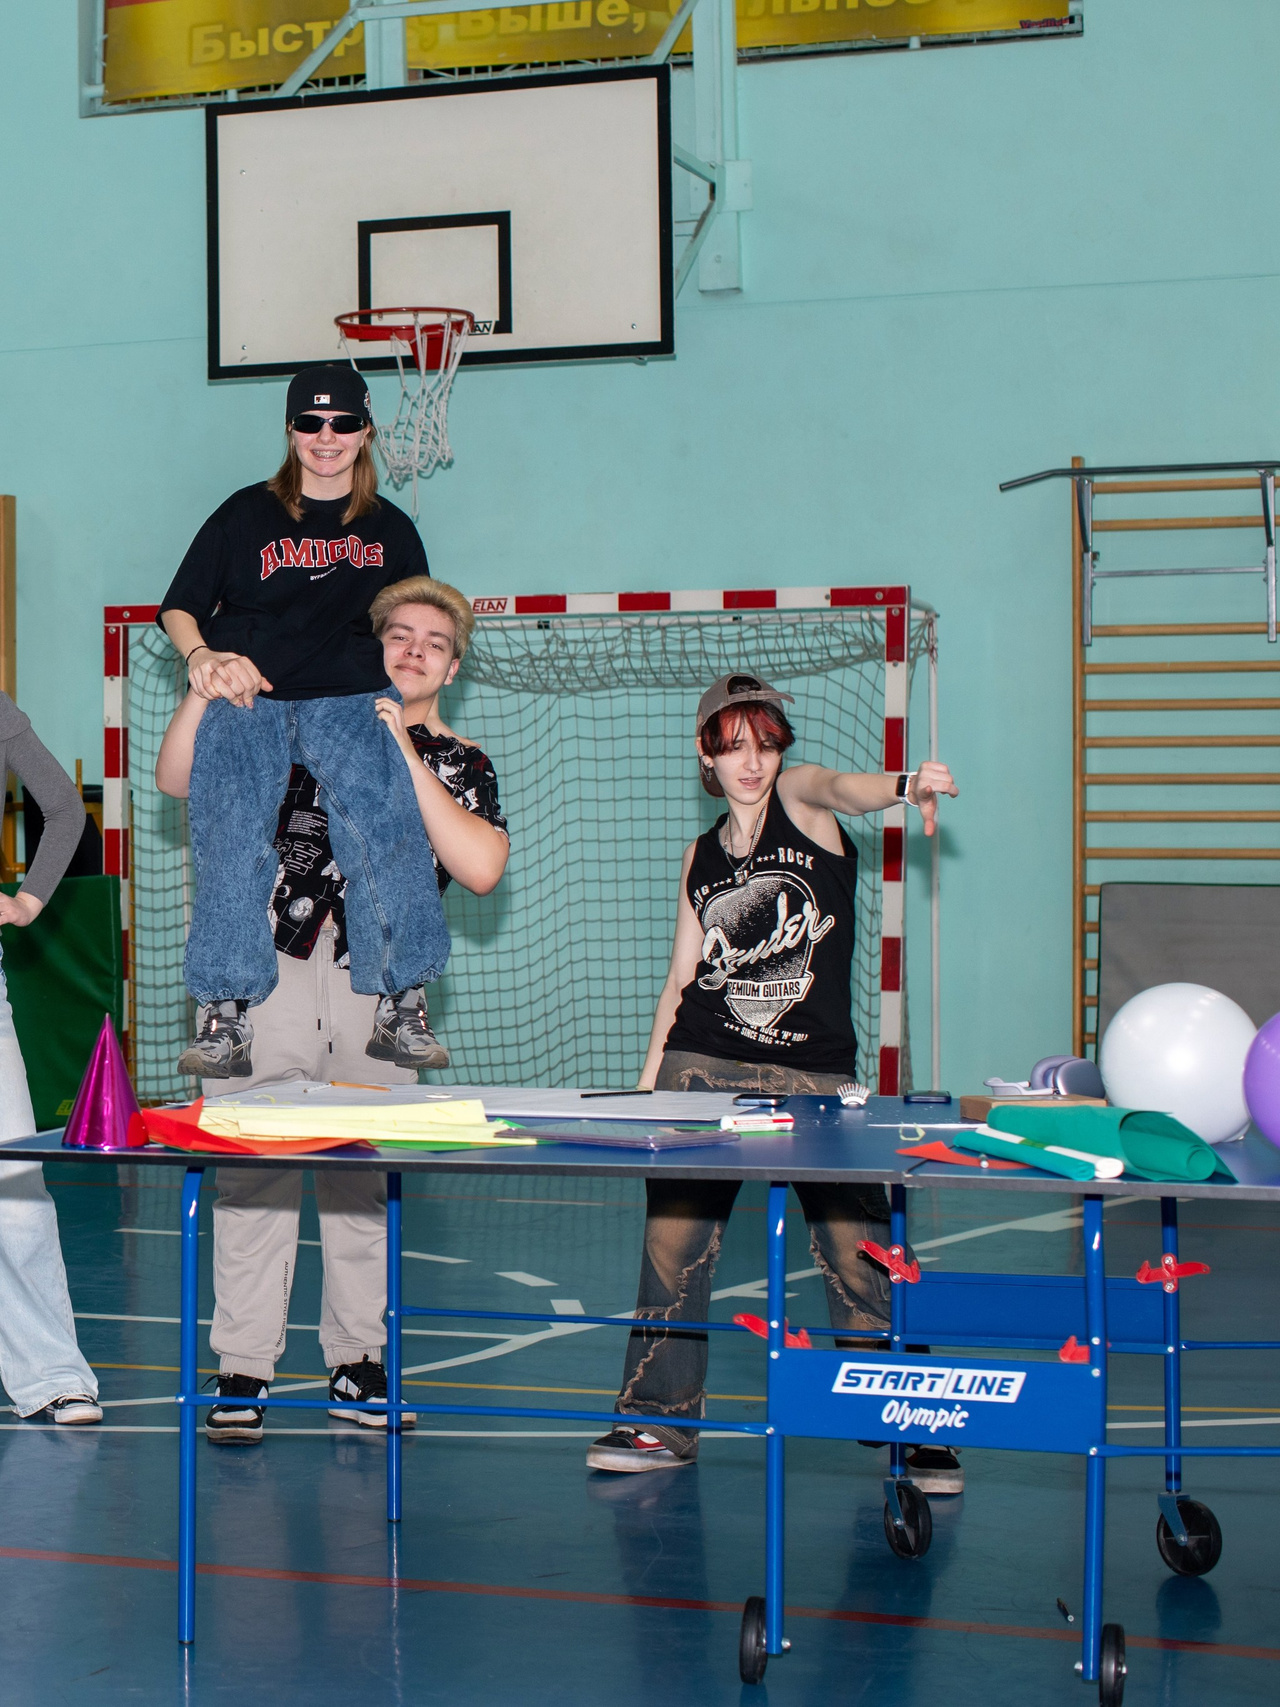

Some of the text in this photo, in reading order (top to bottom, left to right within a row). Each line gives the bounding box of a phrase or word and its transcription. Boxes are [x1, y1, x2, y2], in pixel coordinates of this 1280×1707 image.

[260, 535, 383, 581] AMIGOS
[472, 599, 507, 612] ELAN
[778, 847, 814, 870] ROCK
[728, 981, 800, 998] REMIUM GUITARS
[740, 1026, 759, 1041] SINCE
[841, 1368, 1016, 1397] START LINE
[881, 1399, 969, 1433] Olympic
